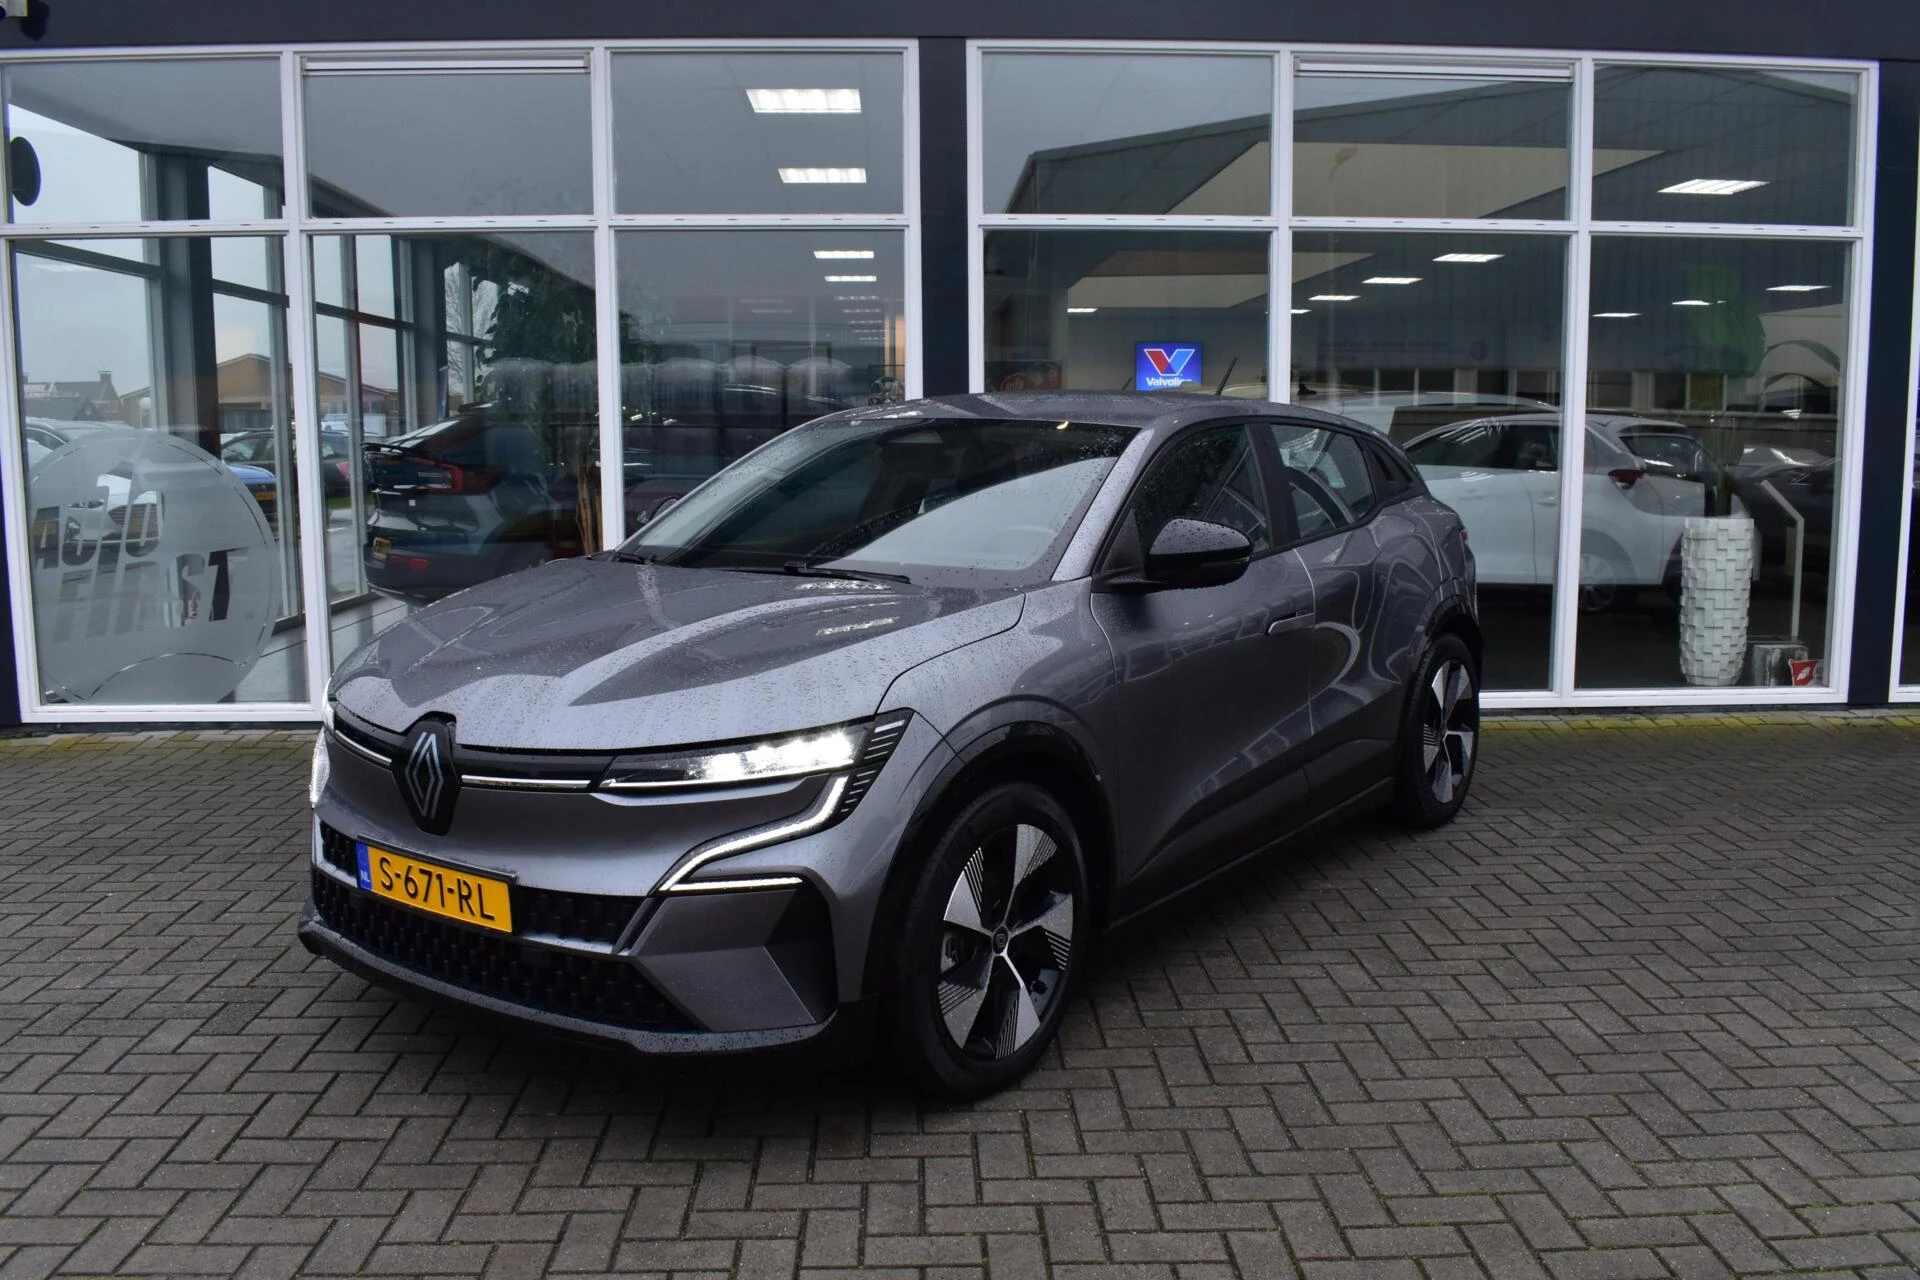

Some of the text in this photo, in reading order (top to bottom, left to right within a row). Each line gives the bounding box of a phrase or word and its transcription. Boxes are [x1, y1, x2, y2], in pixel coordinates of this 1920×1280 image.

[1146, 377, 1192, 386] Valvoli
[32, 461, 165, 569] AUTO
[54, 547, 249, 642] FIRST
[361, 870, 370, 882] NL
[379, 857, 495, 921] S-671-RL
